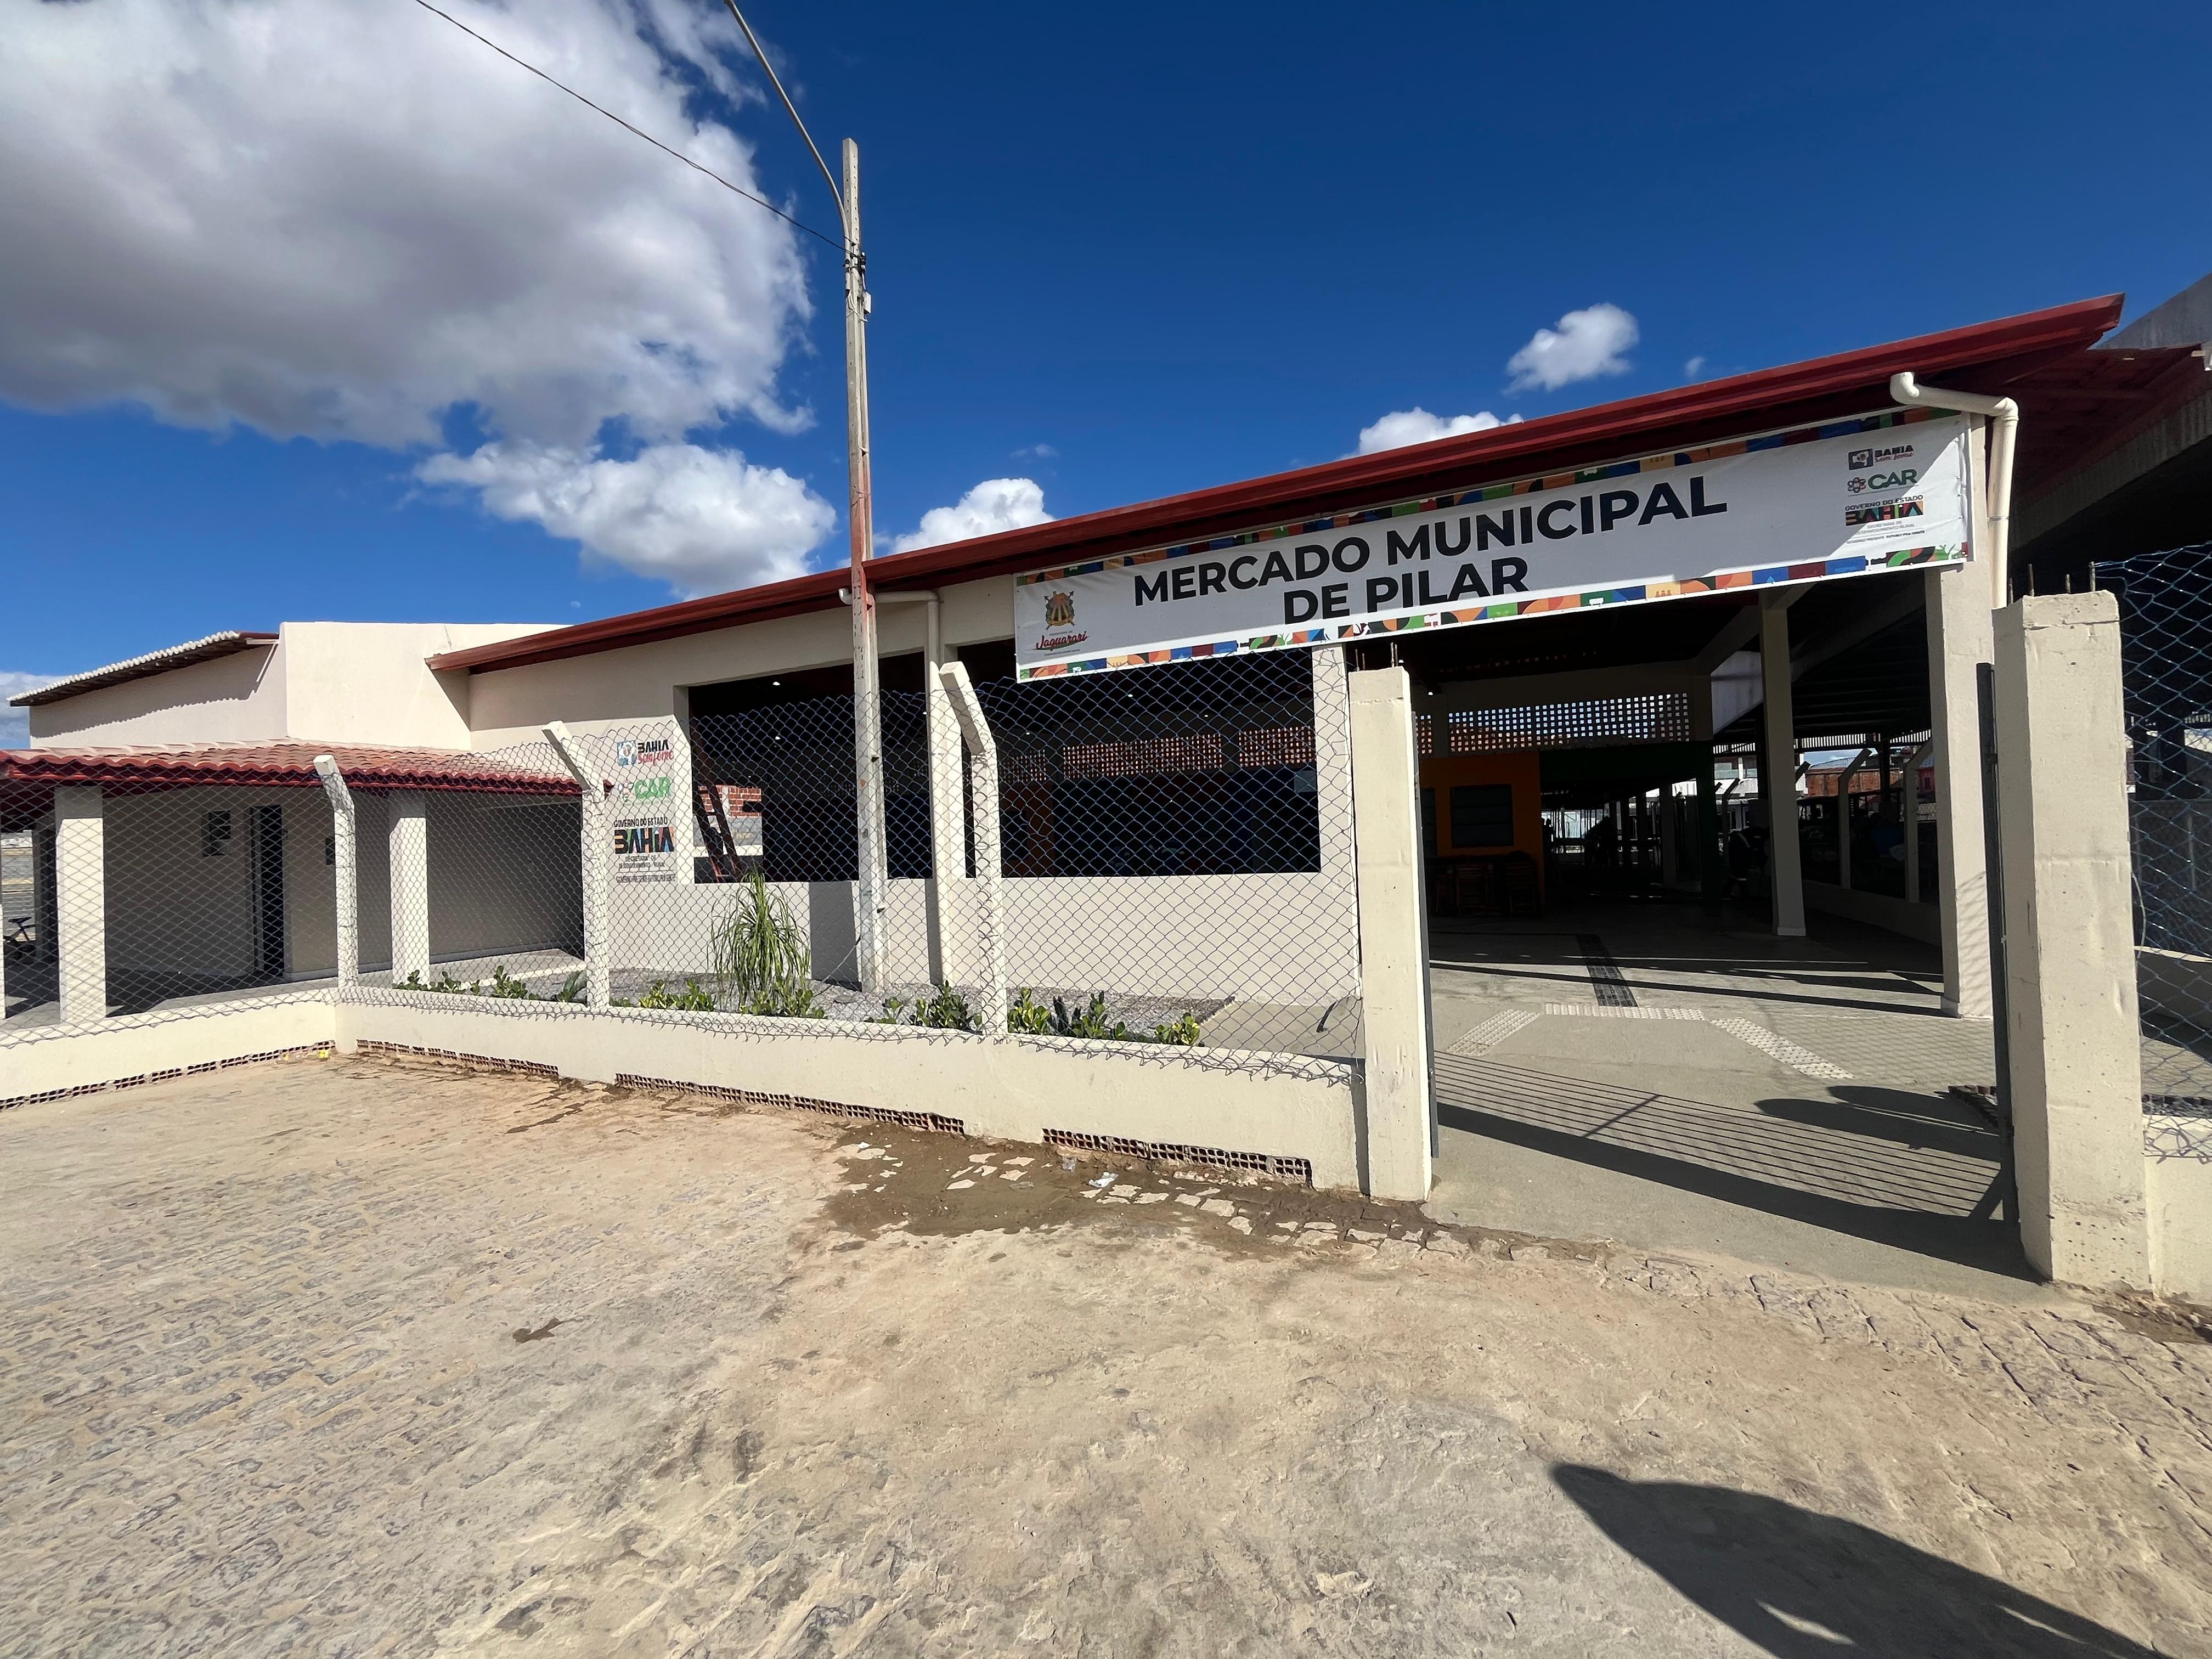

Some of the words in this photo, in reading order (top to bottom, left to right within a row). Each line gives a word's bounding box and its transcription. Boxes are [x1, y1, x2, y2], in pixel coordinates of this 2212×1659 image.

[1874, 444, 1914, 458] BAHIA
[1867, 469, 1917, 489] CAR
[1844, 501, 1881, 511] GOVERNO
[1895, 494, 1923, 504] ESTADO
[1845, 501, 1923, 526] BAHIA
[1134, 537, 1370, 607] MERCADO
[1386, 476, 1728, 566] MUNICIPAL
[1284, 582, 1350, 625] DE
[1366, 556, 1530, 613] PILAR
[1035, 630, 1089, 652] Jaguarari
[637, 739, 669, 754] BAHIA
[634, 776, 672, 799] CAR
[613, 818, 640, 828] GOVERNO
[640, 817, 647, 826] DO
[647, 816, 668, 826] ESTADO
[614, 826, 675, 854] BAHIA
